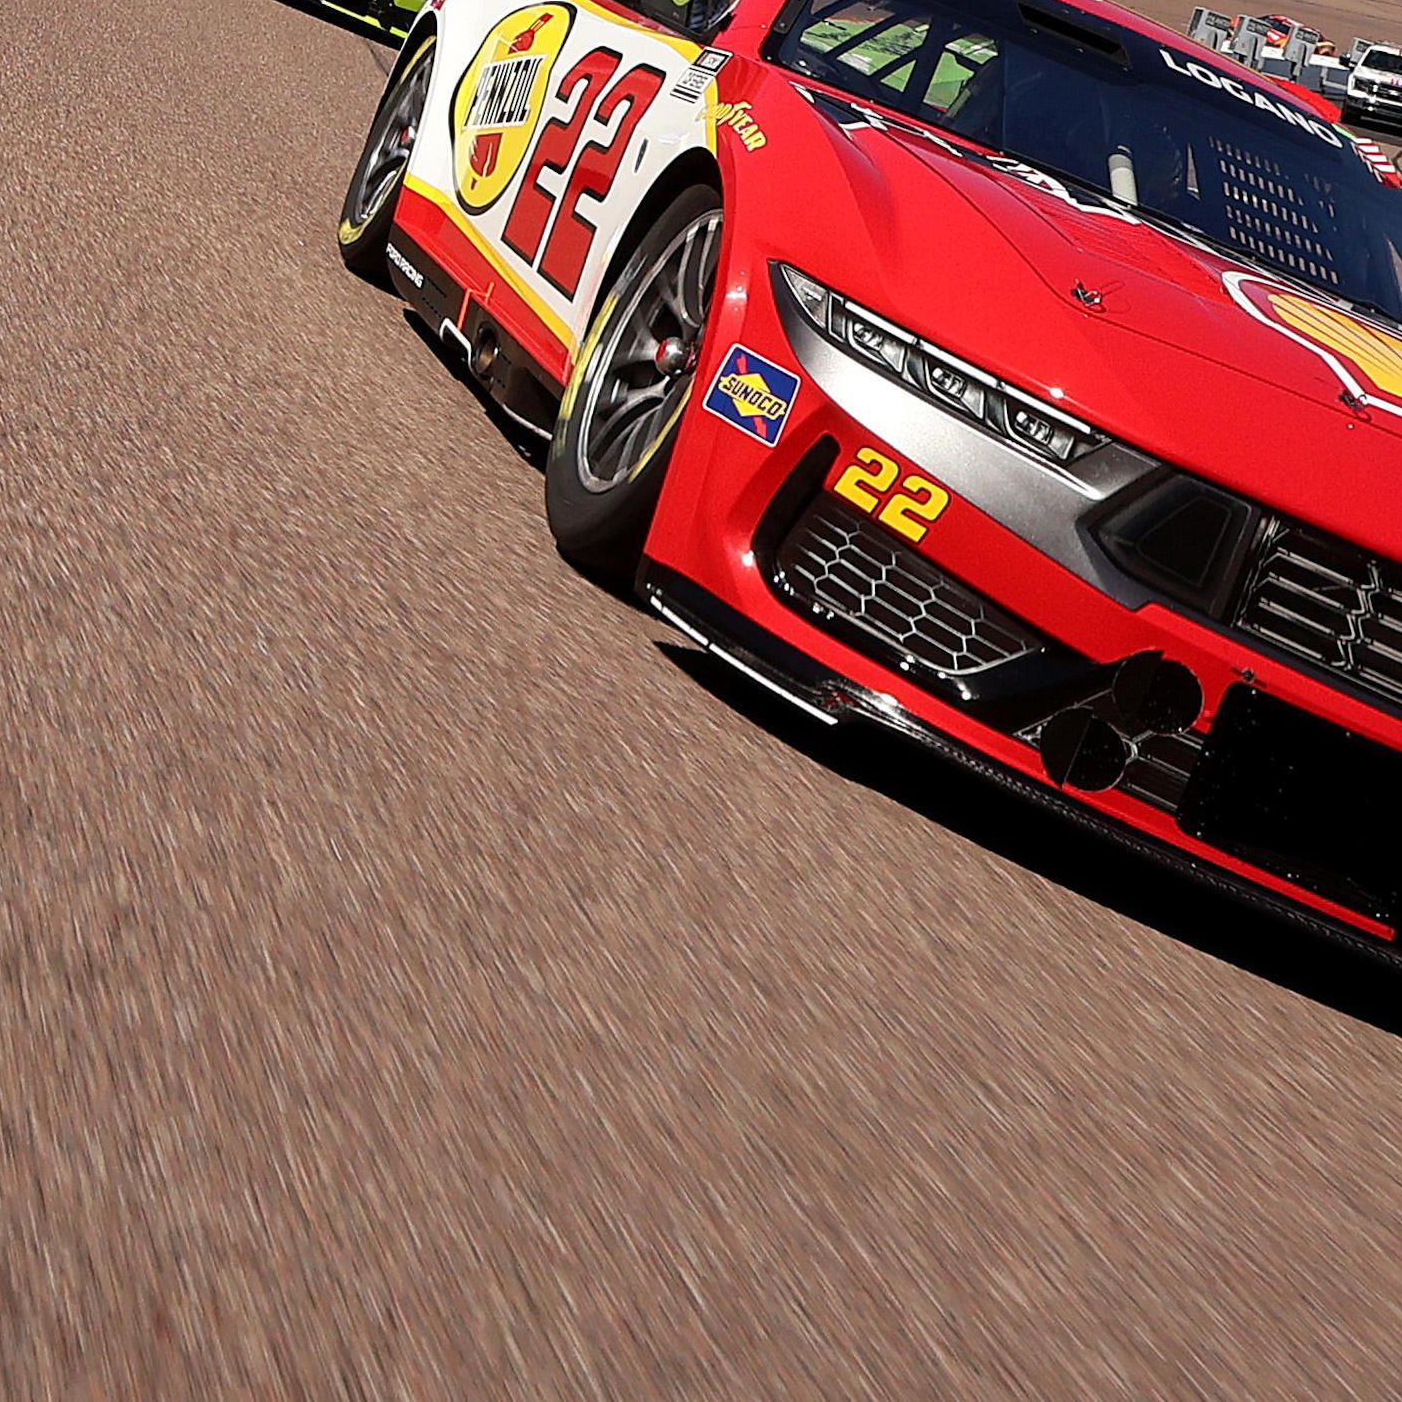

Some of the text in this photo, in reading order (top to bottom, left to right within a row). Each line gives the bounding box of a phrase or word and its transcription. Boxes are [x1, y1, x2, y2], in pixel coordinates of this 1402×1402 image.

[1159, 48, 1343, 148] LOGANO
[501, 46, 666, 303] 22
[725, 377, 786, 418] SUNOCO
[834, 447, 949, 543] 22
